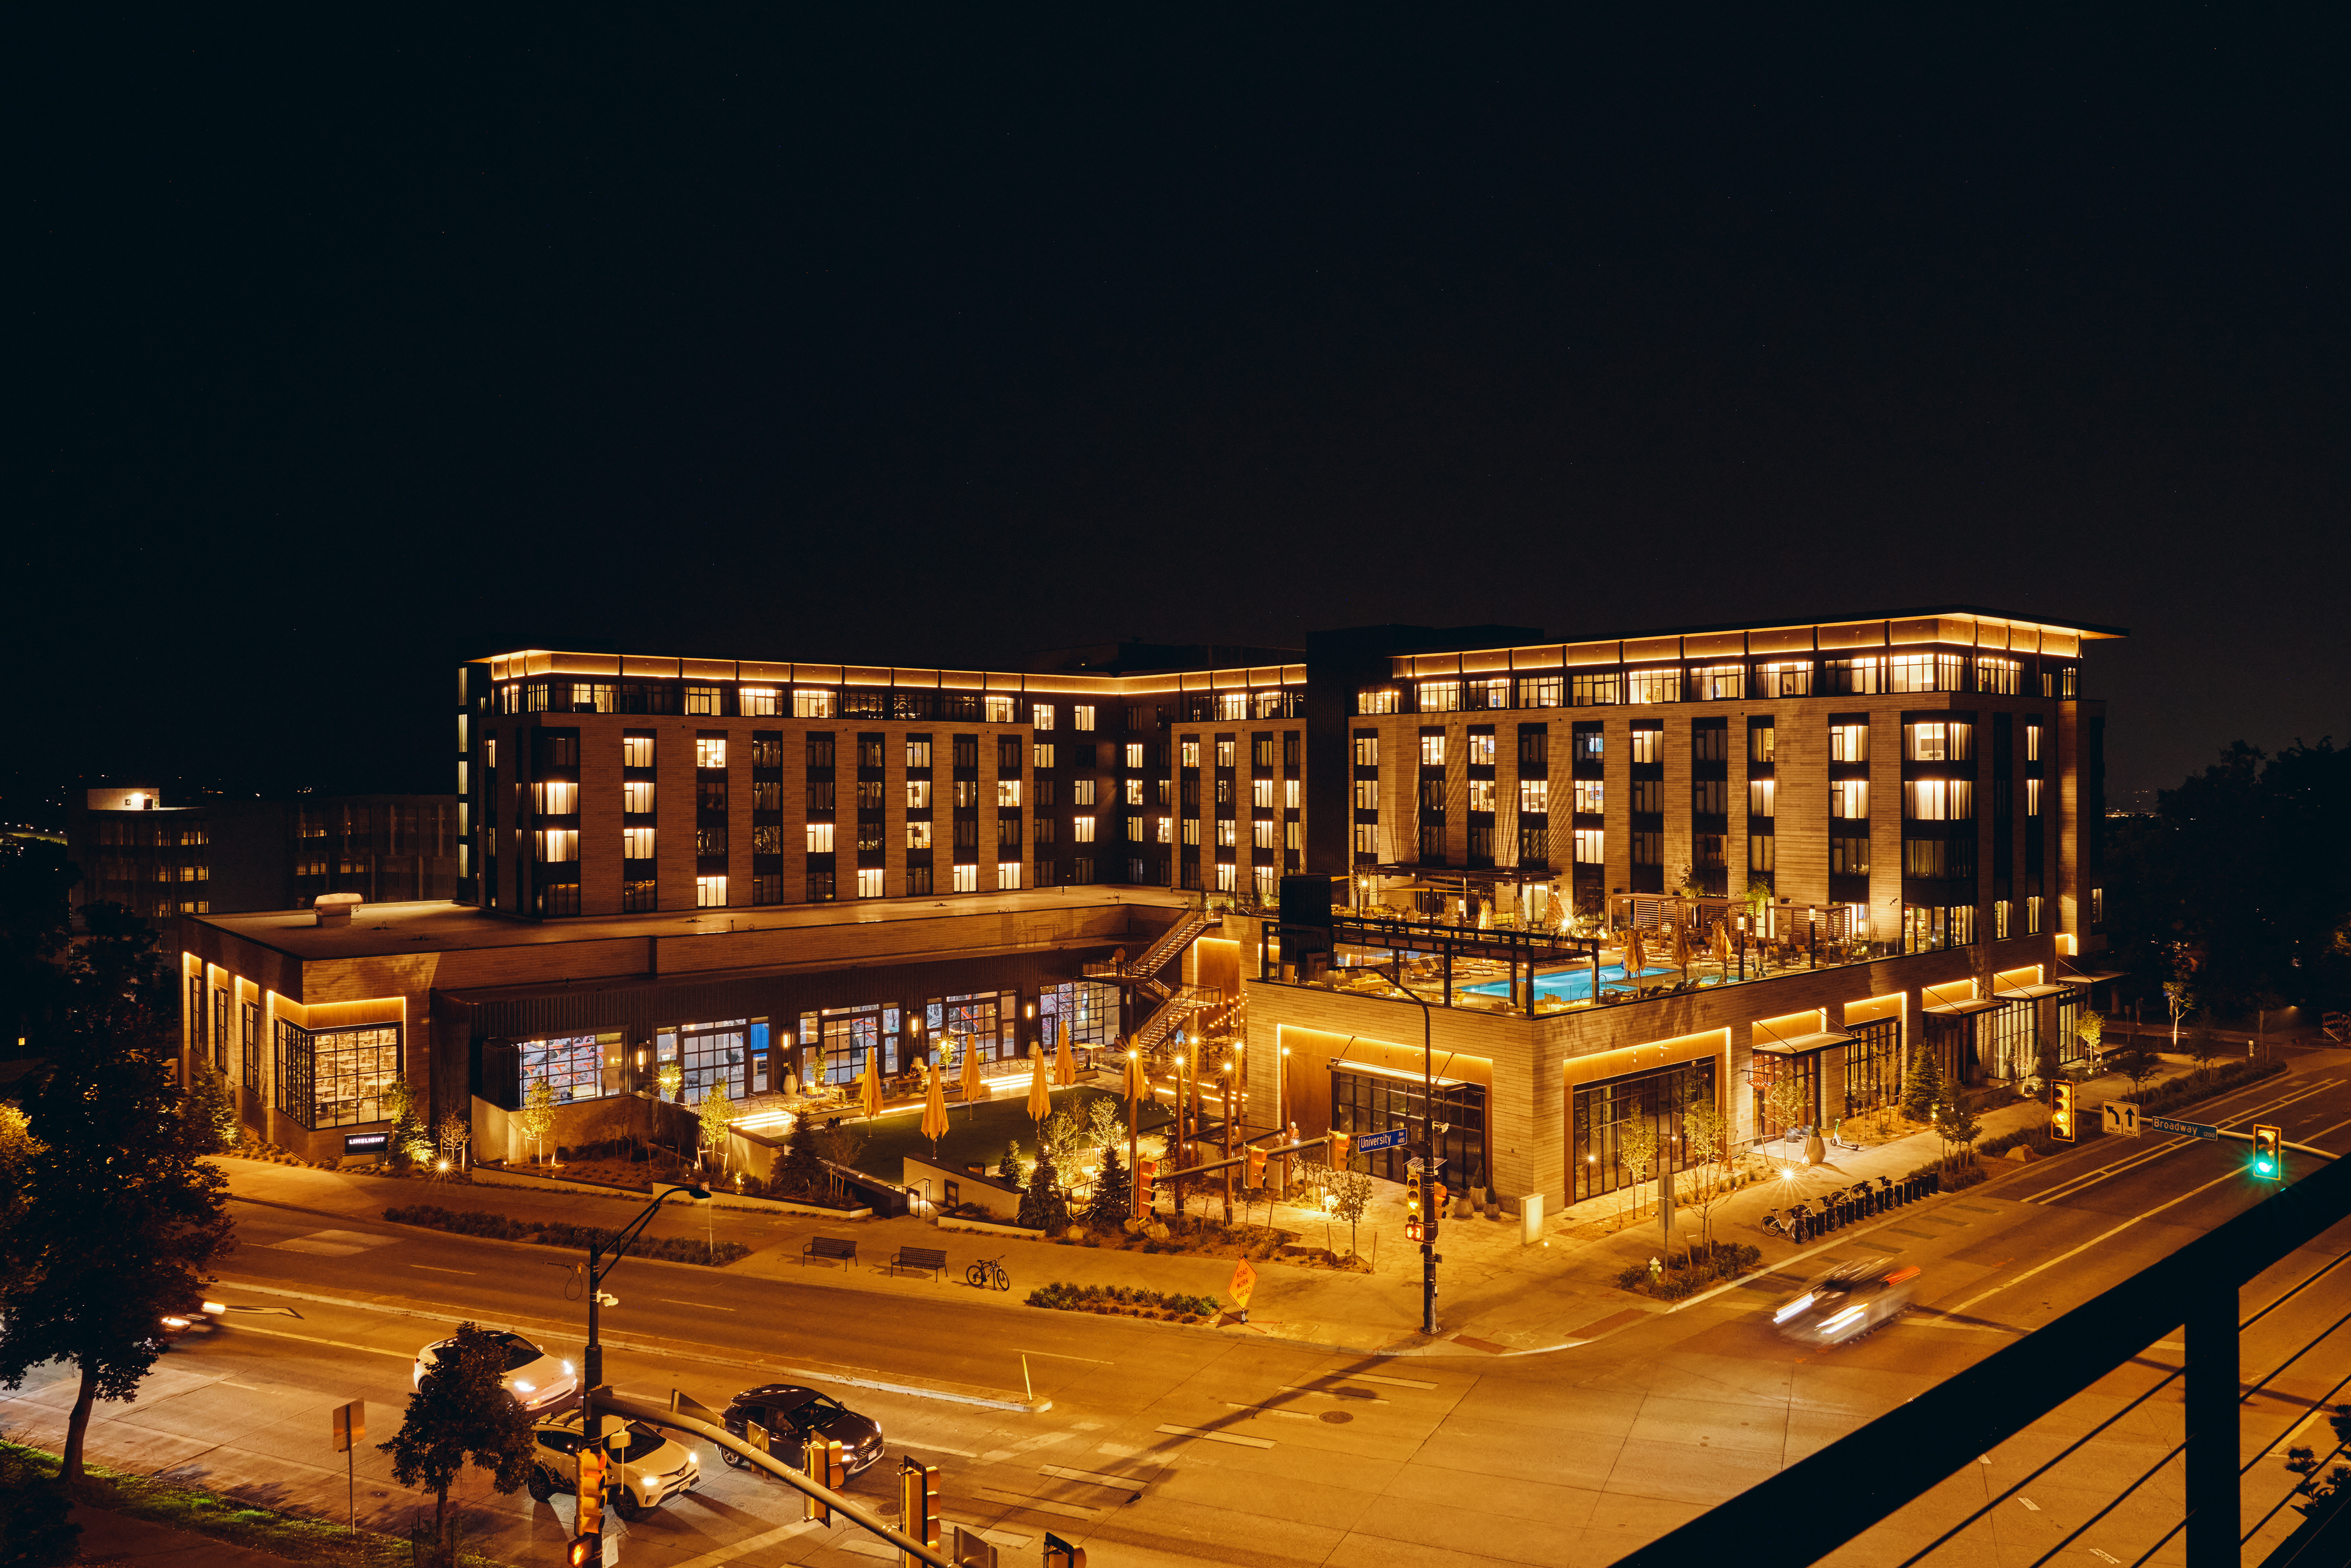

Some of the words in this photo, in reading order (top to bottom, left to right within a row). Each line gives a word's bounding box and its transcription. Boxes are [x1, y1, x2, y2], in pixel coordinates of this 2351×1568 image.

[2154, 1118, 2197, 1136] Broadway
[1361, 1133, 1391, 1148] University
[1237, 1268, 1248, 1279] ROAD
[1237, 1278, 1248, 1289] WORK
[1236, 1287, 1250, 1300] AHEAD
